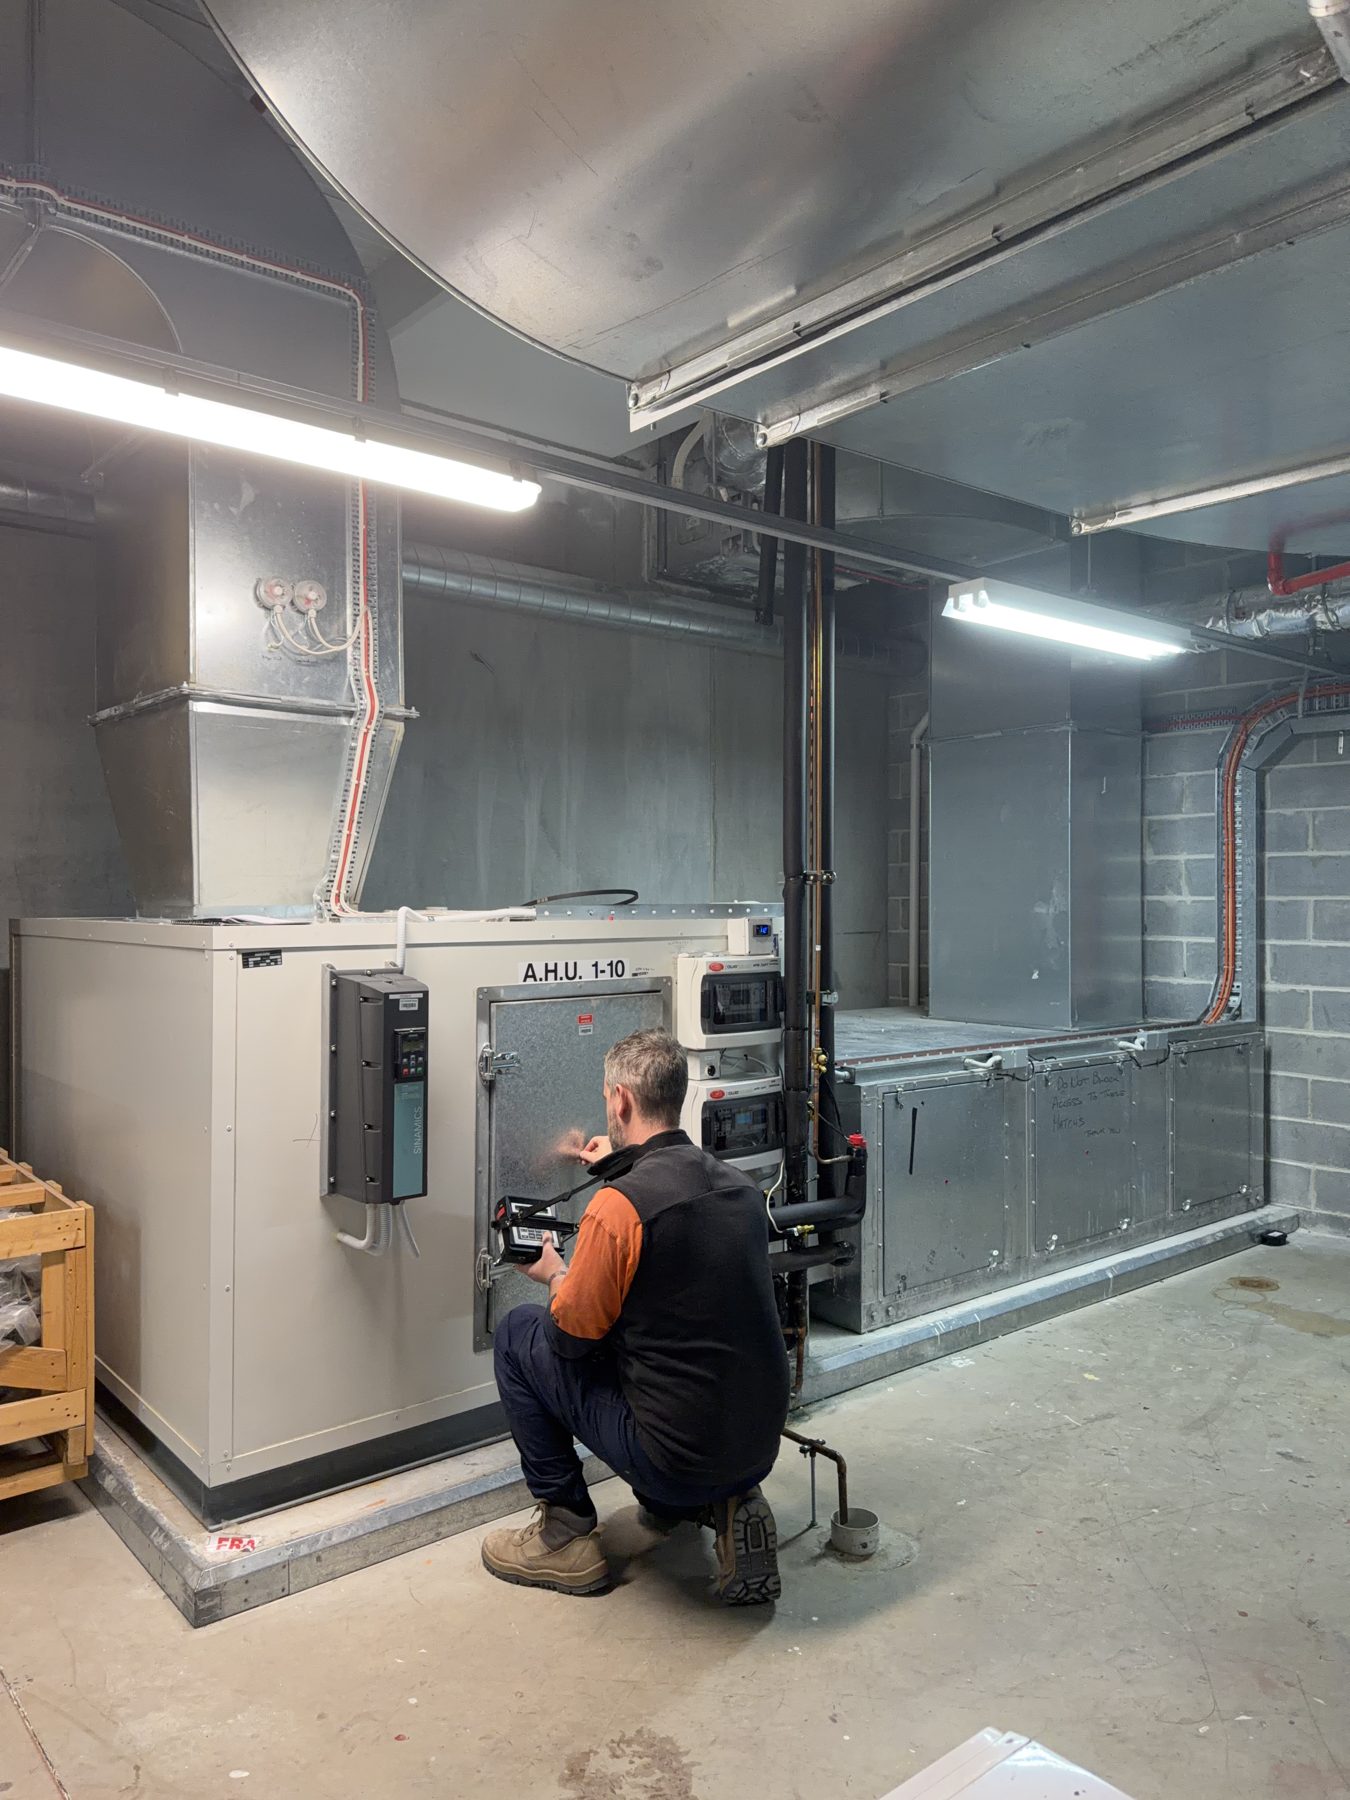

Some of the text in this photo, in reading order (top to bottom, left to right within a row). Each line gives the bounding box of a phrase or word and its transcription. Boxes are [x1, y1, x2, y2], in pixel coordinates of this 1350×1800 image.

[523, 959, 625, 982] A.H.U. 1-10
[413, 1106, 423, 1154] SINAMICS
